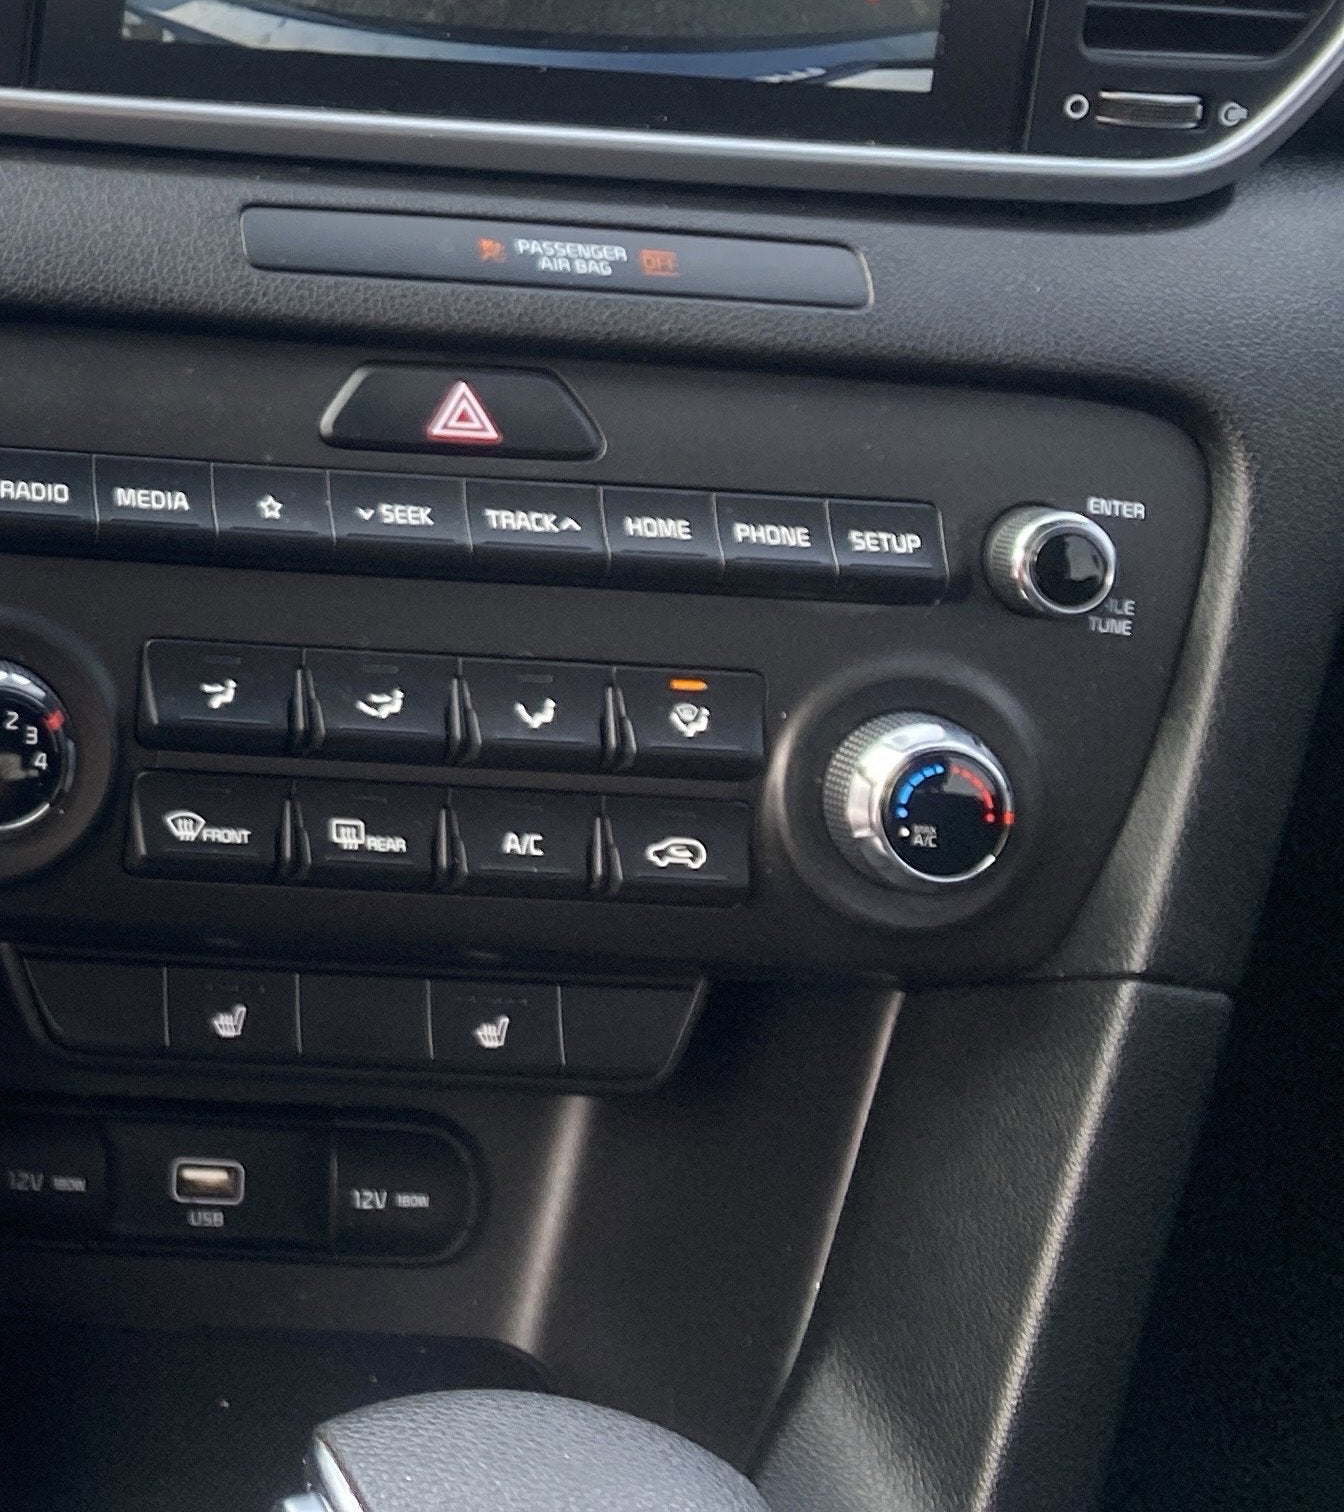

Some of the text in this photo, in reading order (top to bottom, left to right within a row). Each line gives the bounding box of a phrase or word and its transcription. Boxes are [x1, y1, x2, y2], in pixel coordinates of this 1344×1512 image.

[515, 238, 628, 262] PASSENGER
[539, 256, 612, 276] AIR BAG
[0, 479, 70, 503] RADIO
[116, 487, 190, 513] MEDIA
[382, 503, 434, 526] SEEK
[1087, 496, 1146, 520] ENTER
[486, 509, 557, 533] TRACK
[625, 517, 692, 540] HOME
[734, 523, 811, 549] PHONE
[848, 530, 922, 554] SETUP
[1088, 615, 1133, 636] TUNE
[5, 711, 19, 730] 2
[25, 726, 38, 745] 3
[34, 752, 48, 770] 4
[202, 826, 251, 844] FRONT
[366, 835, 407, 854] REAR
[503, 833, 544, 857] A/C
[913, 834, 937, 848] A/C
[352, 1189, 388, 1210] 12V
[189, 1210, 225, 1228] USB
